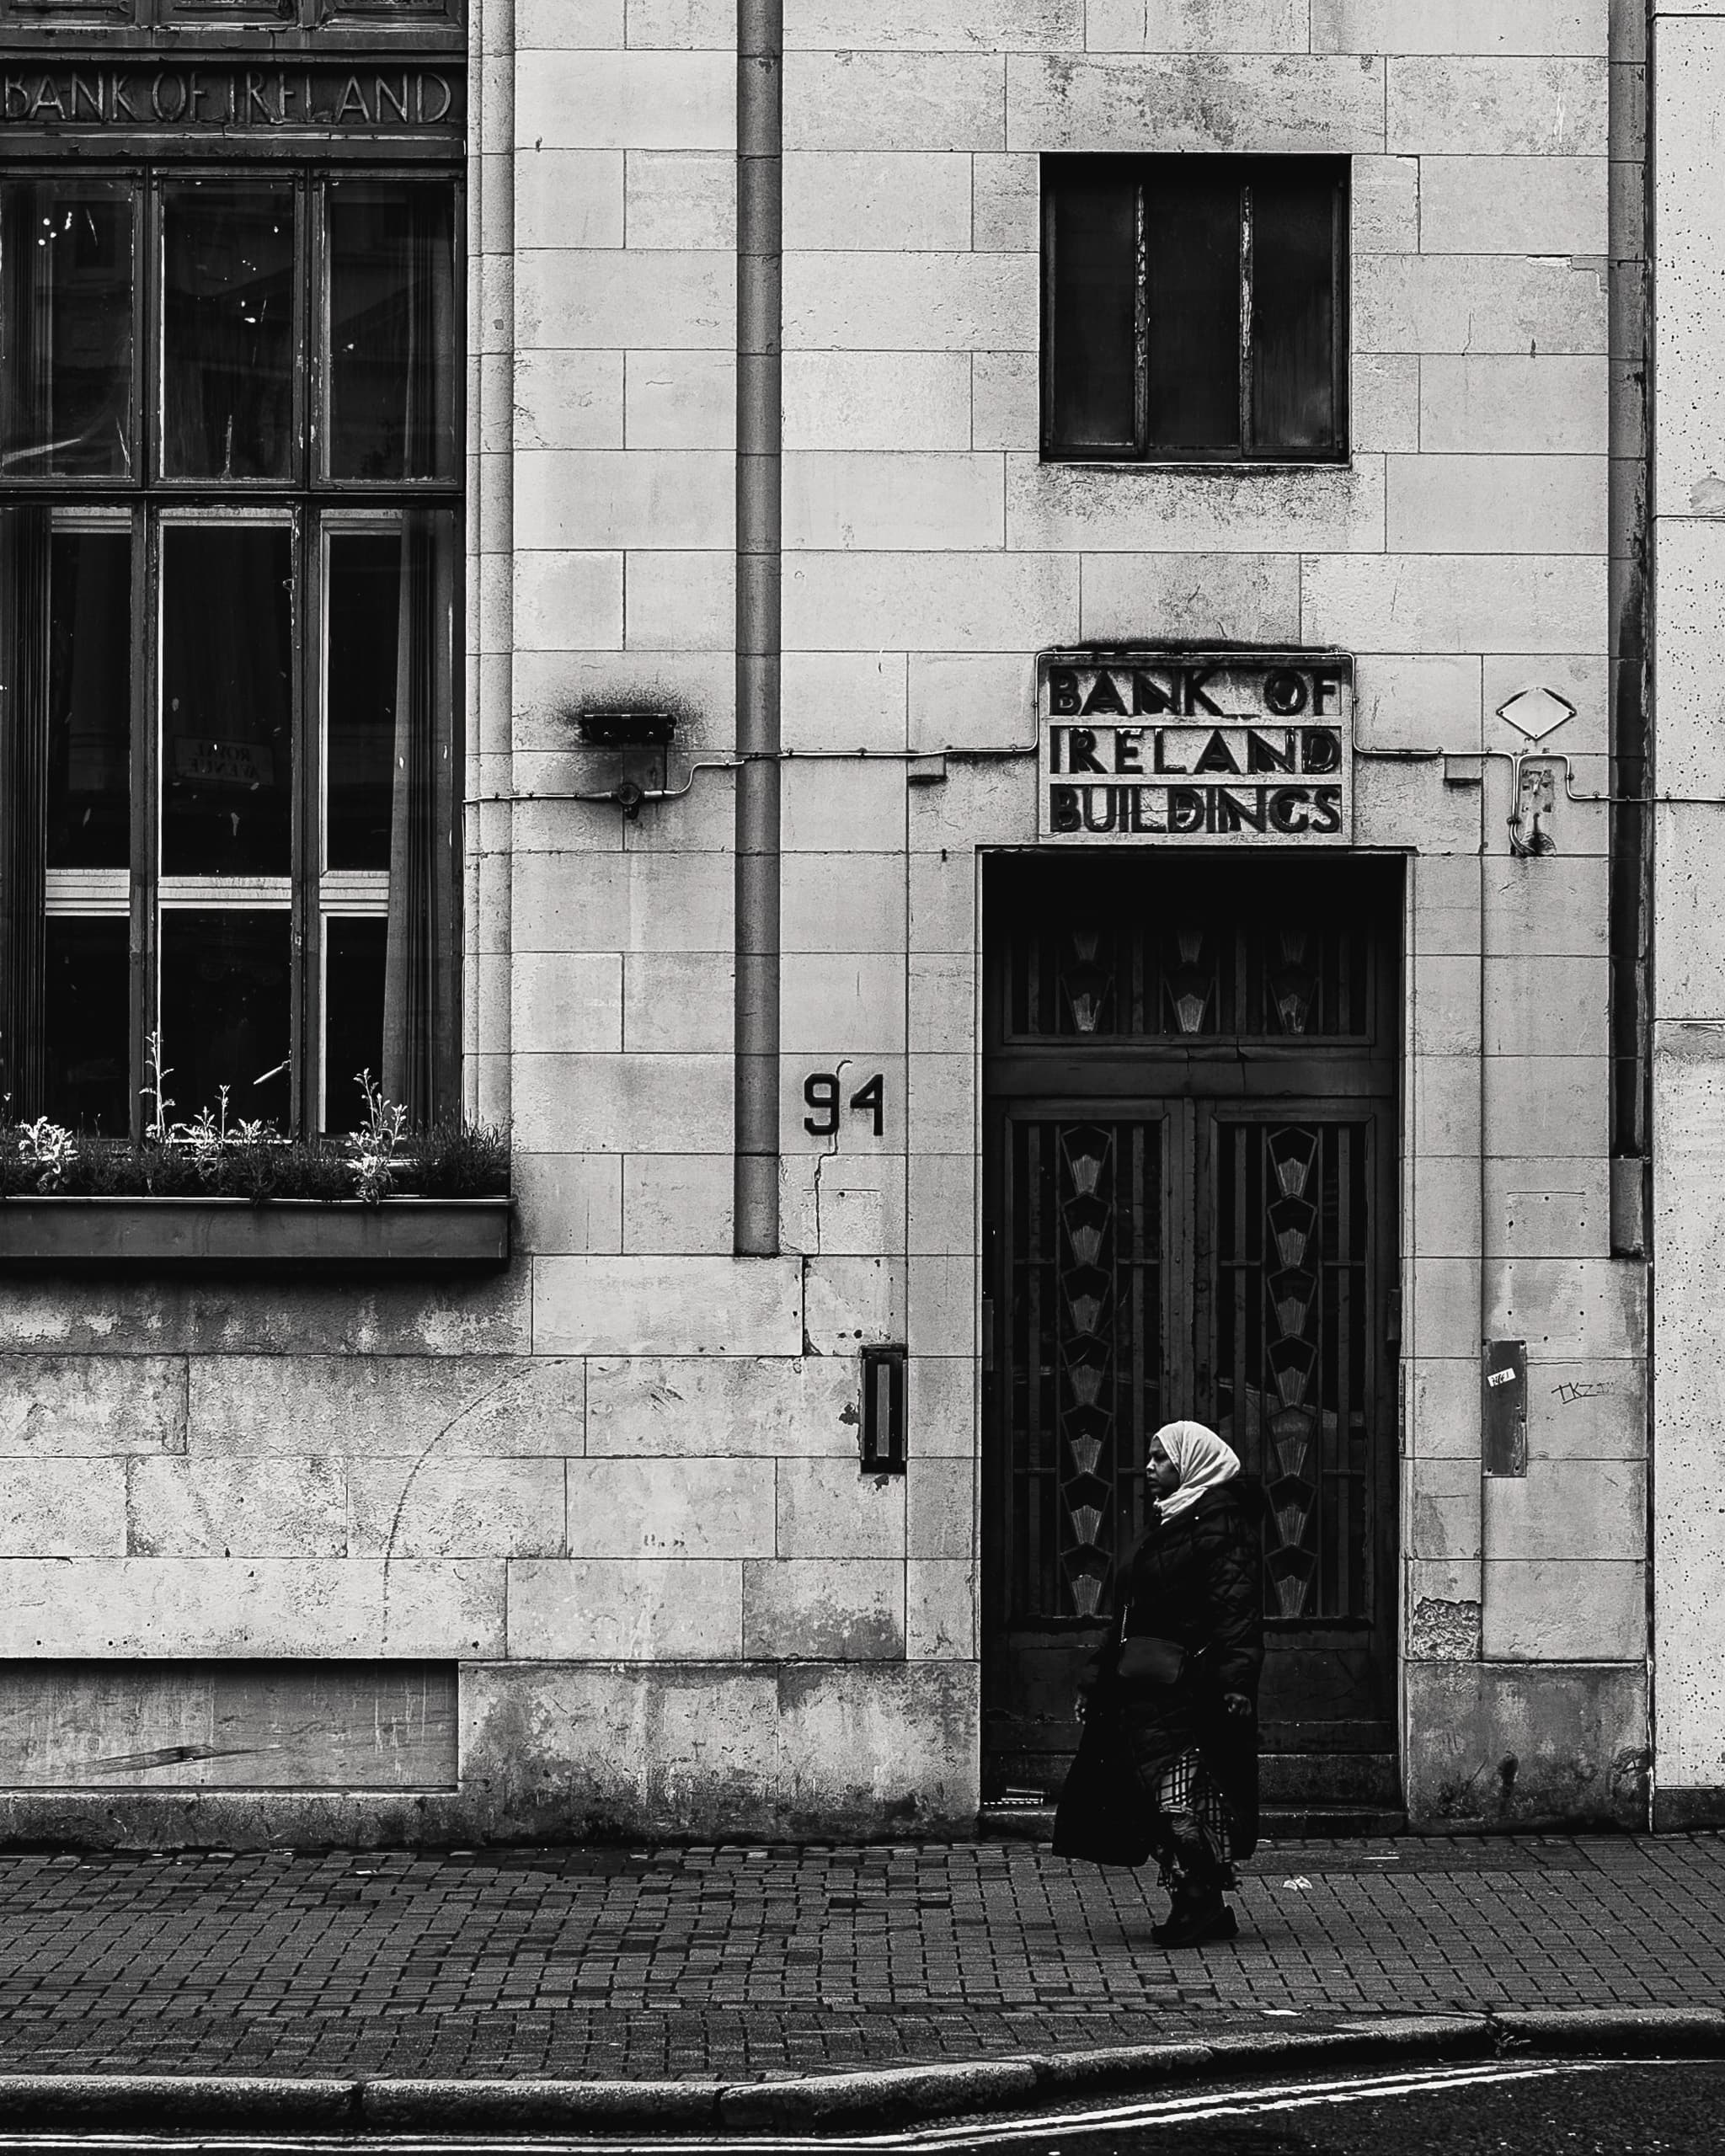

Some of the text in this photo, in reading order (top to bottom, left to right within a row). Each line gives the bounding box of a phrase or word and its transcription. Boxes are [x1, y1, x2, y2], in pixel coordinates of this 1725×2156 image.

[4, 71, 451, 124] BANK OF IRELAND
[1050, 671, 1341, 716] BANK OF
[1050, 728, 1340, 774] IRELAND
[1050, 787, 1341, 833] BUILDINGS
[804, 1073, 884, 1136] 94
